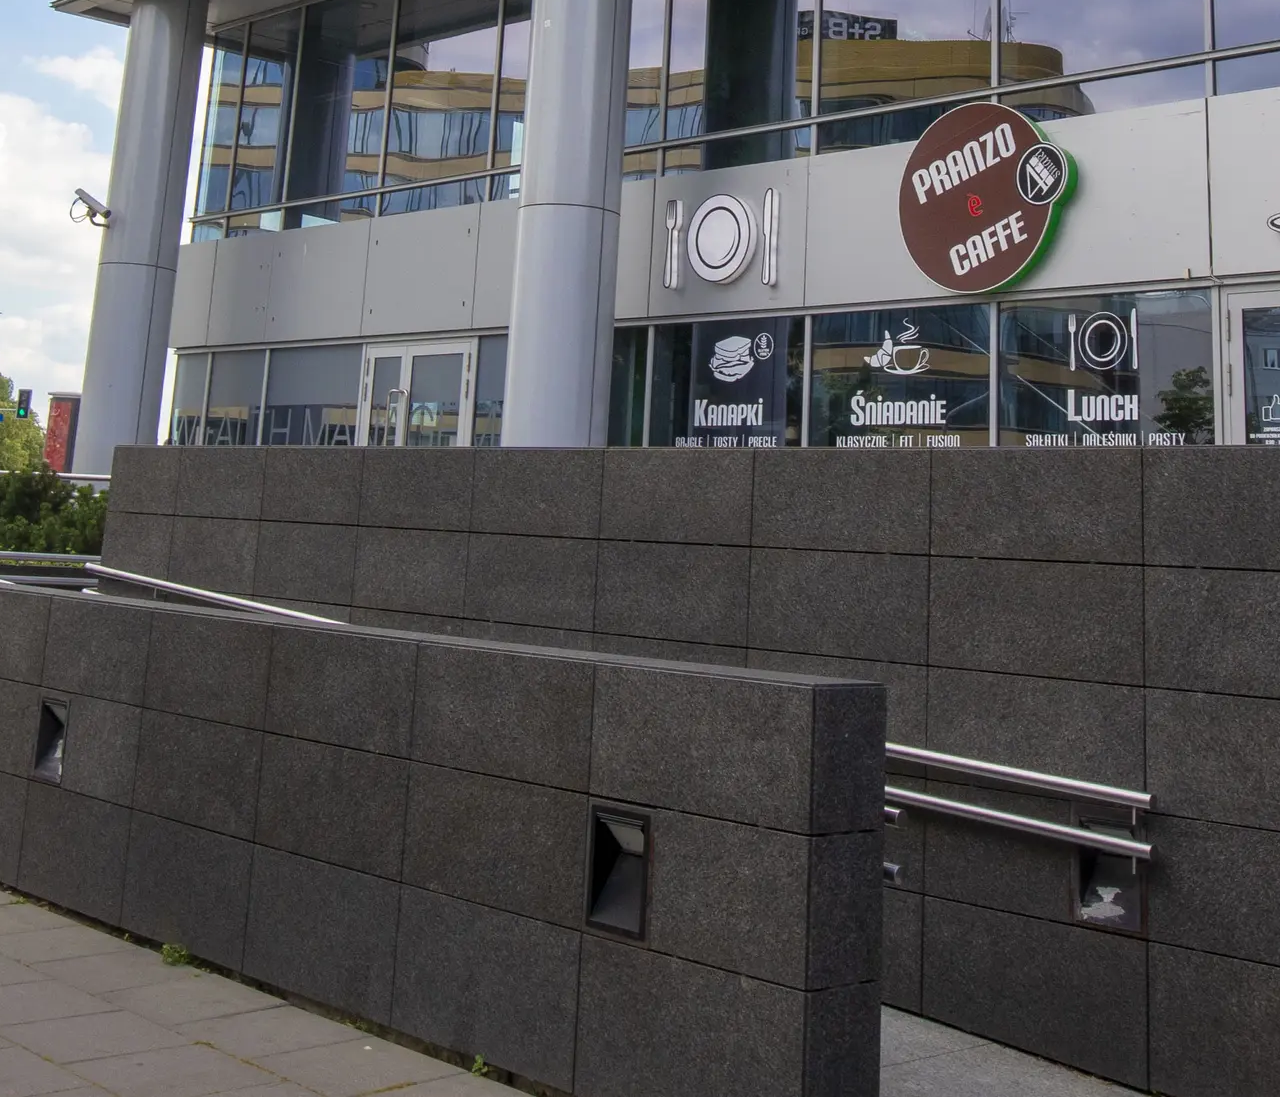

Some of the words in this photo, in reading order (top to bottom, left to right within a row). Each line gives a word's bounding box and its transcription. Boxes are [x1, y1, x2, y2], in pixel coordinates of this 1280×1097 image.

[911, 123, 1016, 205] PRANZO
[949, 210, 1028, 277] CAFFE
[713, 436, 738, 448] TOSTY
[836, 435, 887, 448] KLASYCZNE
[900, 435, 914, 448] FIT
[926, 434, 960, 448] FUSION
[1025, 434, 1068, 447] SAŁATKI
[1082, 431, 1136, 447] NALEŚNIKI
[1148, 432, 1186, 446] PASTY
